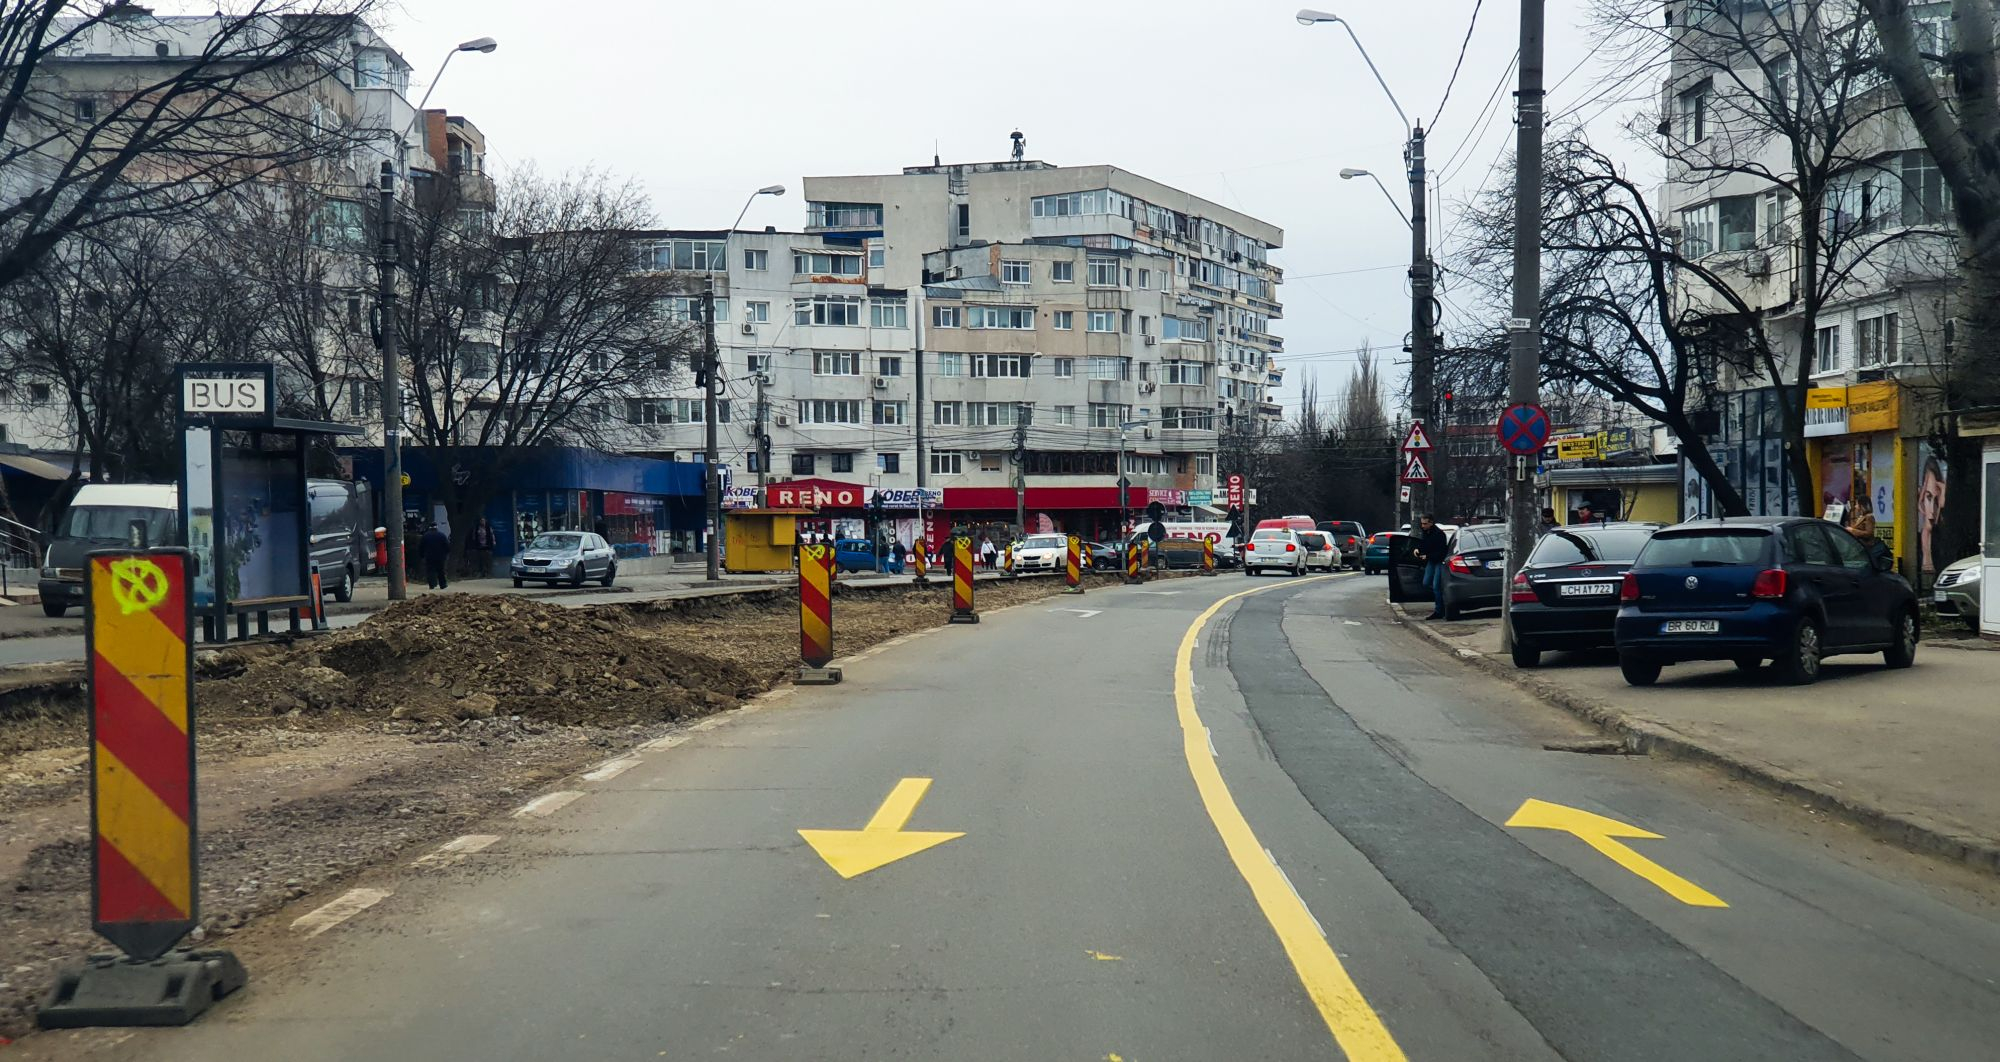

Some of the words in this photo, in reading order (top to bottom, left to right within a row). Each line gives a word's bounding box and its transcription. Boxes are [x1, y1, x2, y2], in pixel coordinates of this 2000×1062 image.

[191, 382, 257, 408] BUS
[778, 490, 853, 505] RENO
[1568, 585, 1581, 595] CH
[1583, 585, 1593, 595] AY
[1594, 584, 1611, 594] 722
[1667, 621, 1682, 631] BR
[1685, 621, 1697, 631] 60
[1699, 621, 1715, 630] RIA
